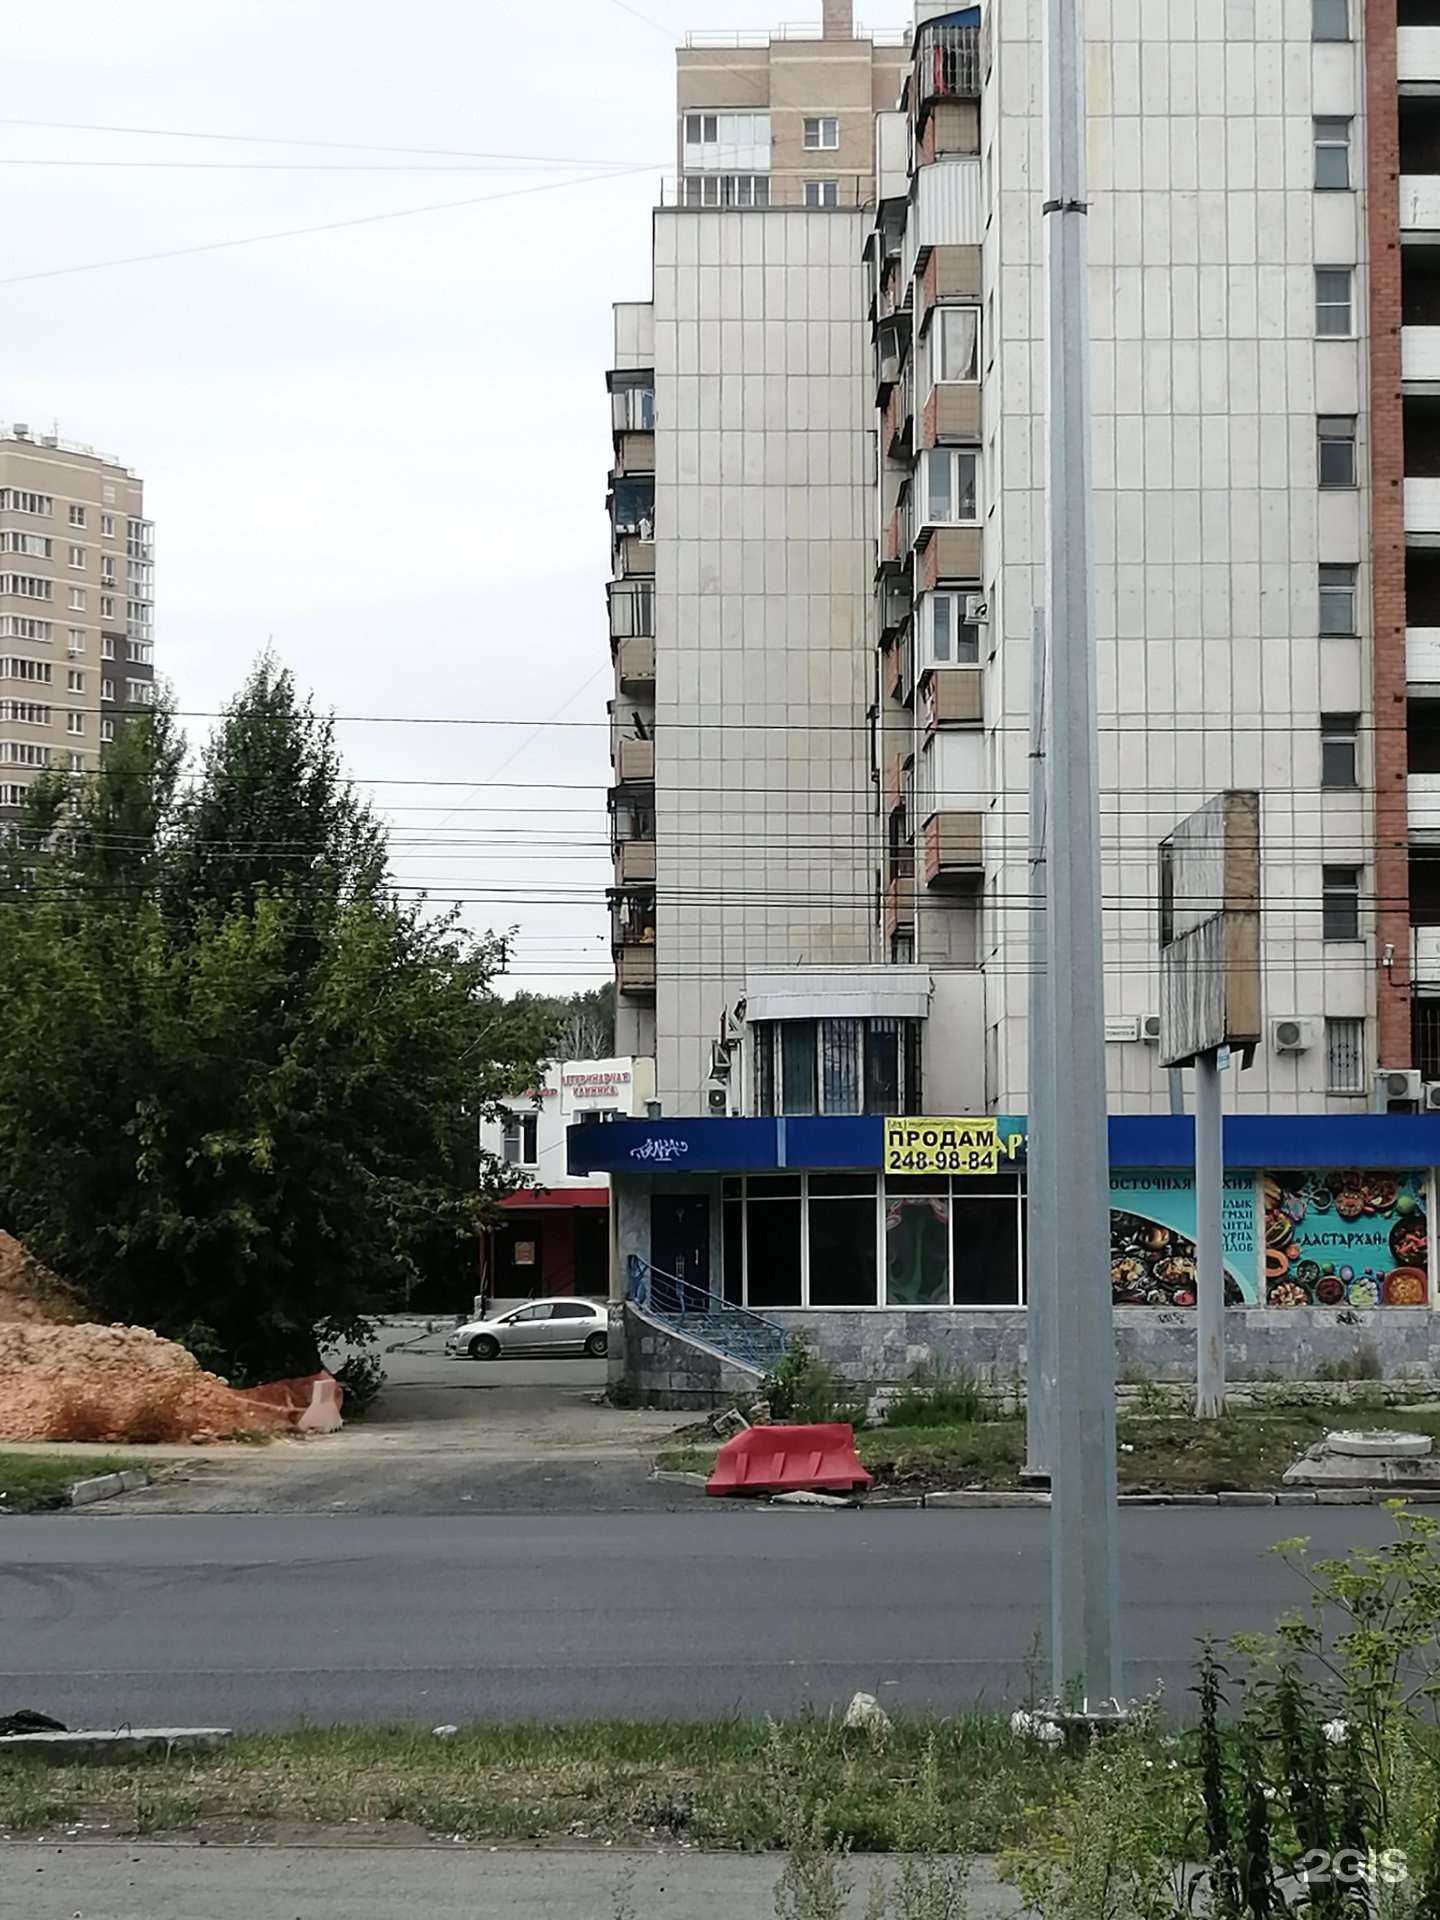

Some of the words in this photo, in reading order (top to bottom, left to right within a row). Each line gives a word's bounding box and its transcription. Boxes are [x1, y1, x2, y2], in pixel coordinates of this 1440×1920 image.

[888, 1131, 994, 1149] ПРОДАМ
[889, 1151, 993, 1170] 248-98-84
[1109, 1177, 1191, 1190] ОСТОЧНАЯ
[1222, 1177, 1253, 1190] ХНЯ
[1222, 1210, 1253, 1219] ГМАН
[1223, 1231, 1253, 1242] УРПА
